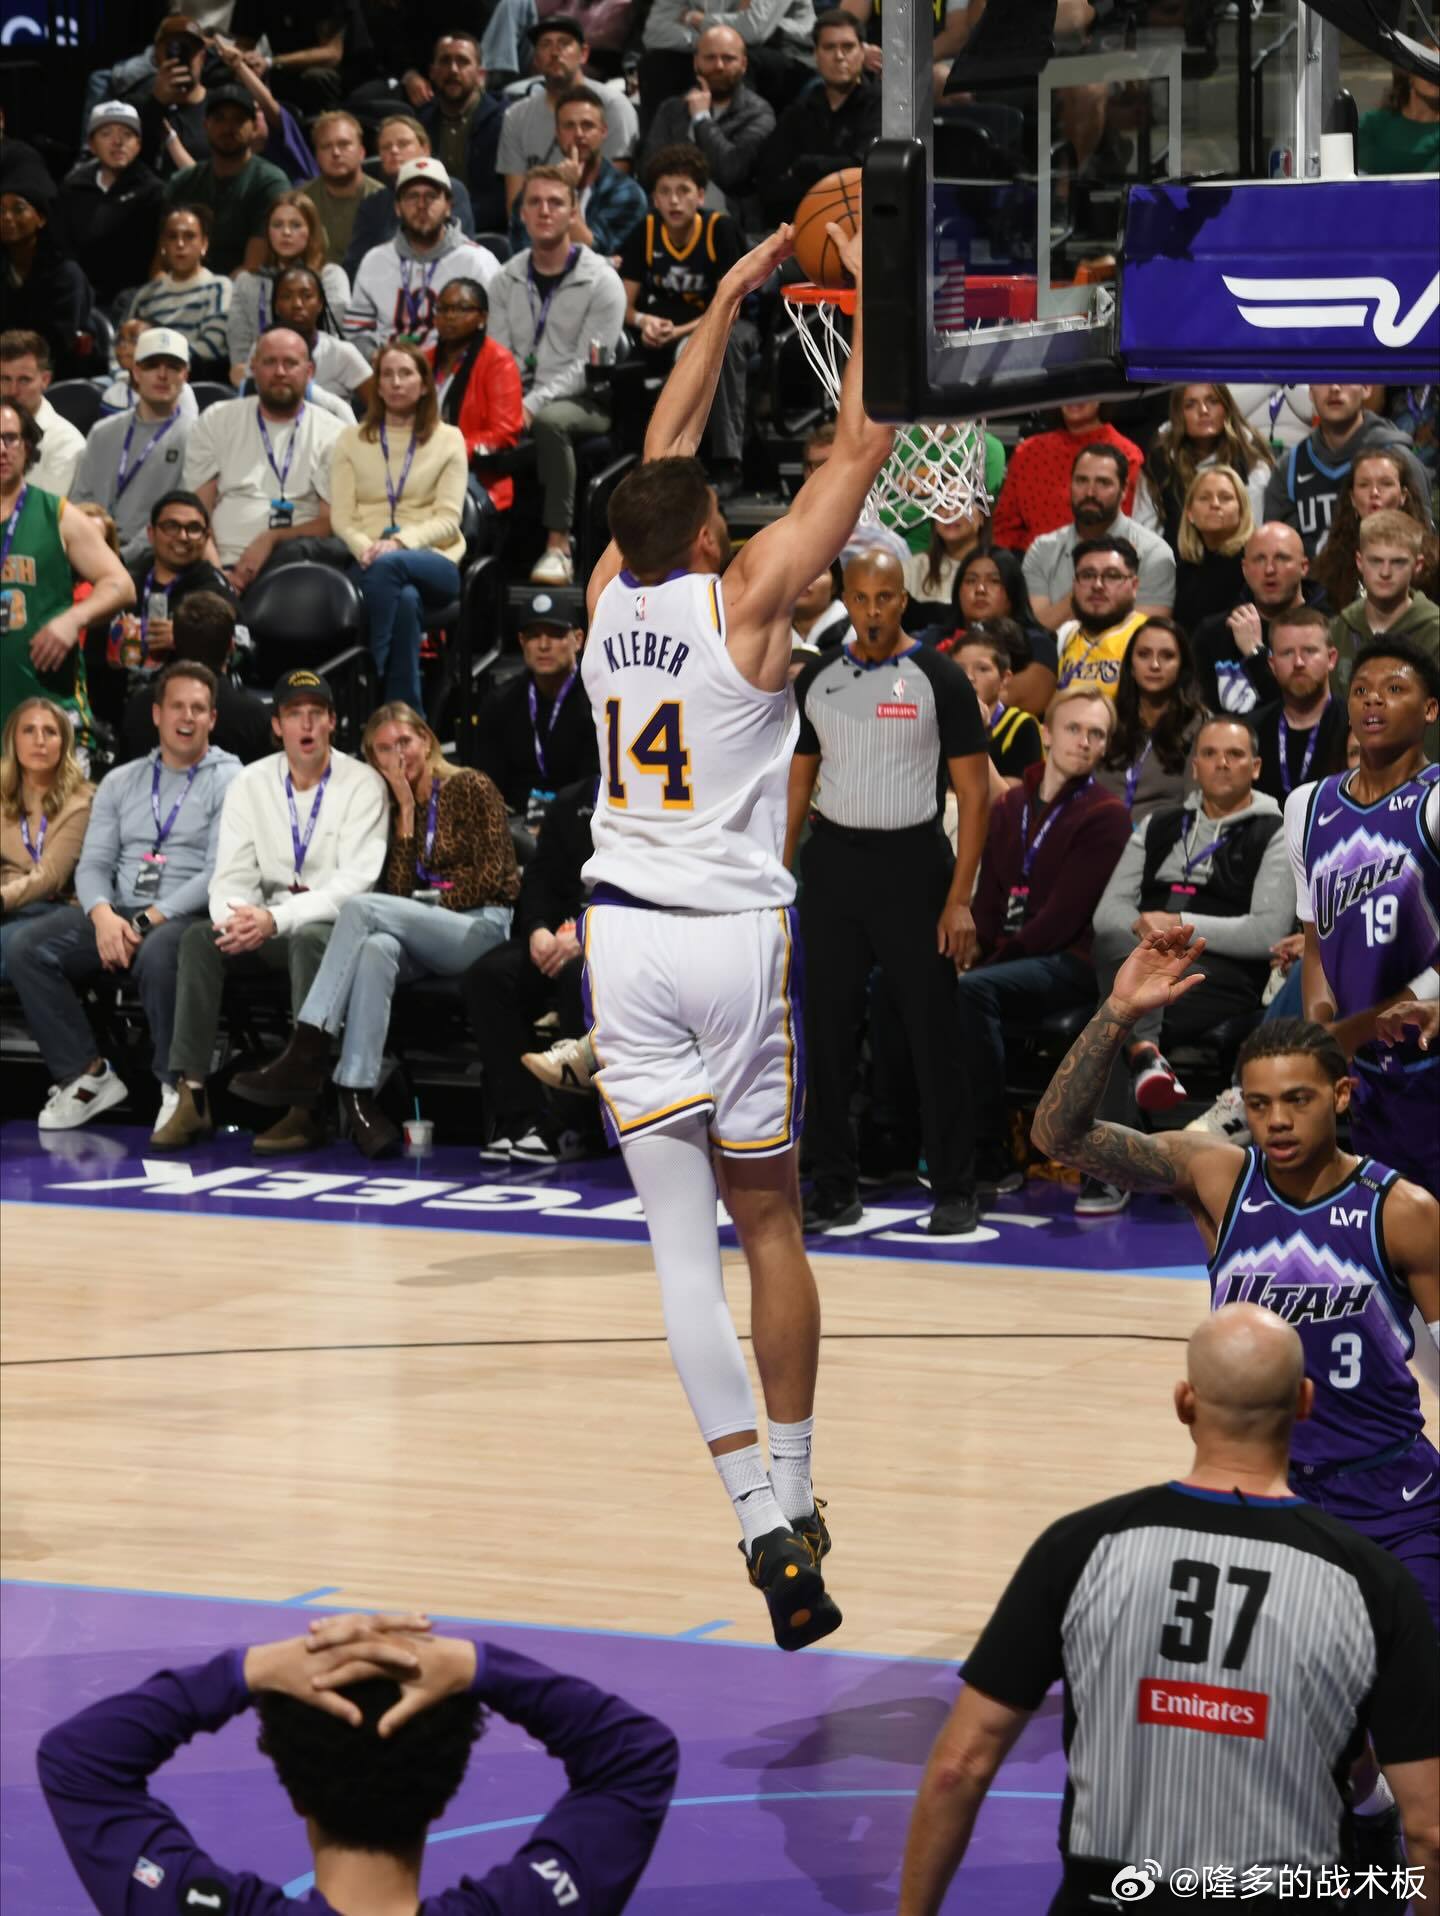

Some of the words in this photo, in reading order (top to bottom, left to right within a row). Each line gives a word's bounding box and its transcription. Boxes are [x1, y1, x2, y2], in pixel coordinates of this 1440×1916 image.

[603, 631, 690, 677] KLEBER
[878, 705, 917, 718] Emirates
[605, 696, 693, 810] 14
[1389, 795, 1418, 811] LVT
[1313, 848, 1412, 939] UTAH
[1360, 894, 1398, 947] 19
[1330, 1206, 1368, 1228] LVT
[1329, 1332, 1362, 1389] 3
[1159, 1559, 1271, 1671] 37
[1150, 1688, 1256, 1724] Emirates
[529, 1858, 579, 1907] LVT
